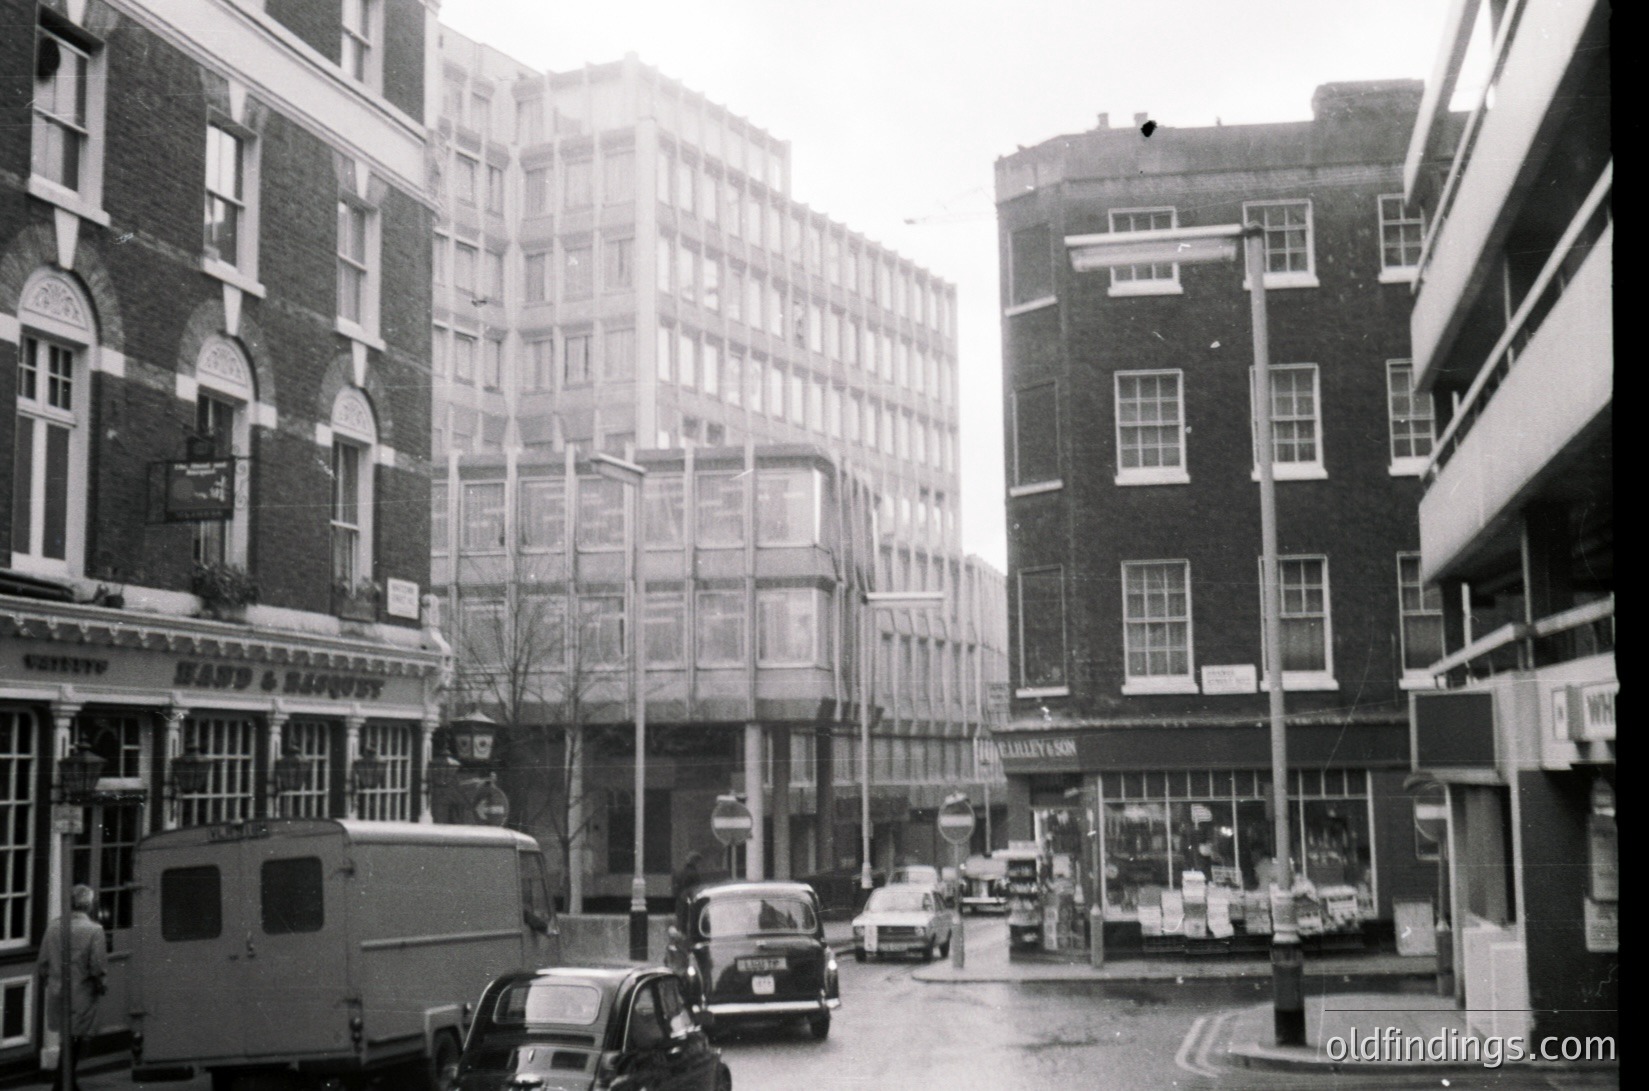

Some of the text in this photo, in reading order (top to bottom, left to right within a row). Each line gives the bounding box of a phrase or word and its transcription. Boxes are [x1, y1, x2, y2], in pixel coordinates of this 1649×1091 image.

[174, 660, 386, 700] HAND & RACQUET
[1053, 738, 1078, 757] SON
